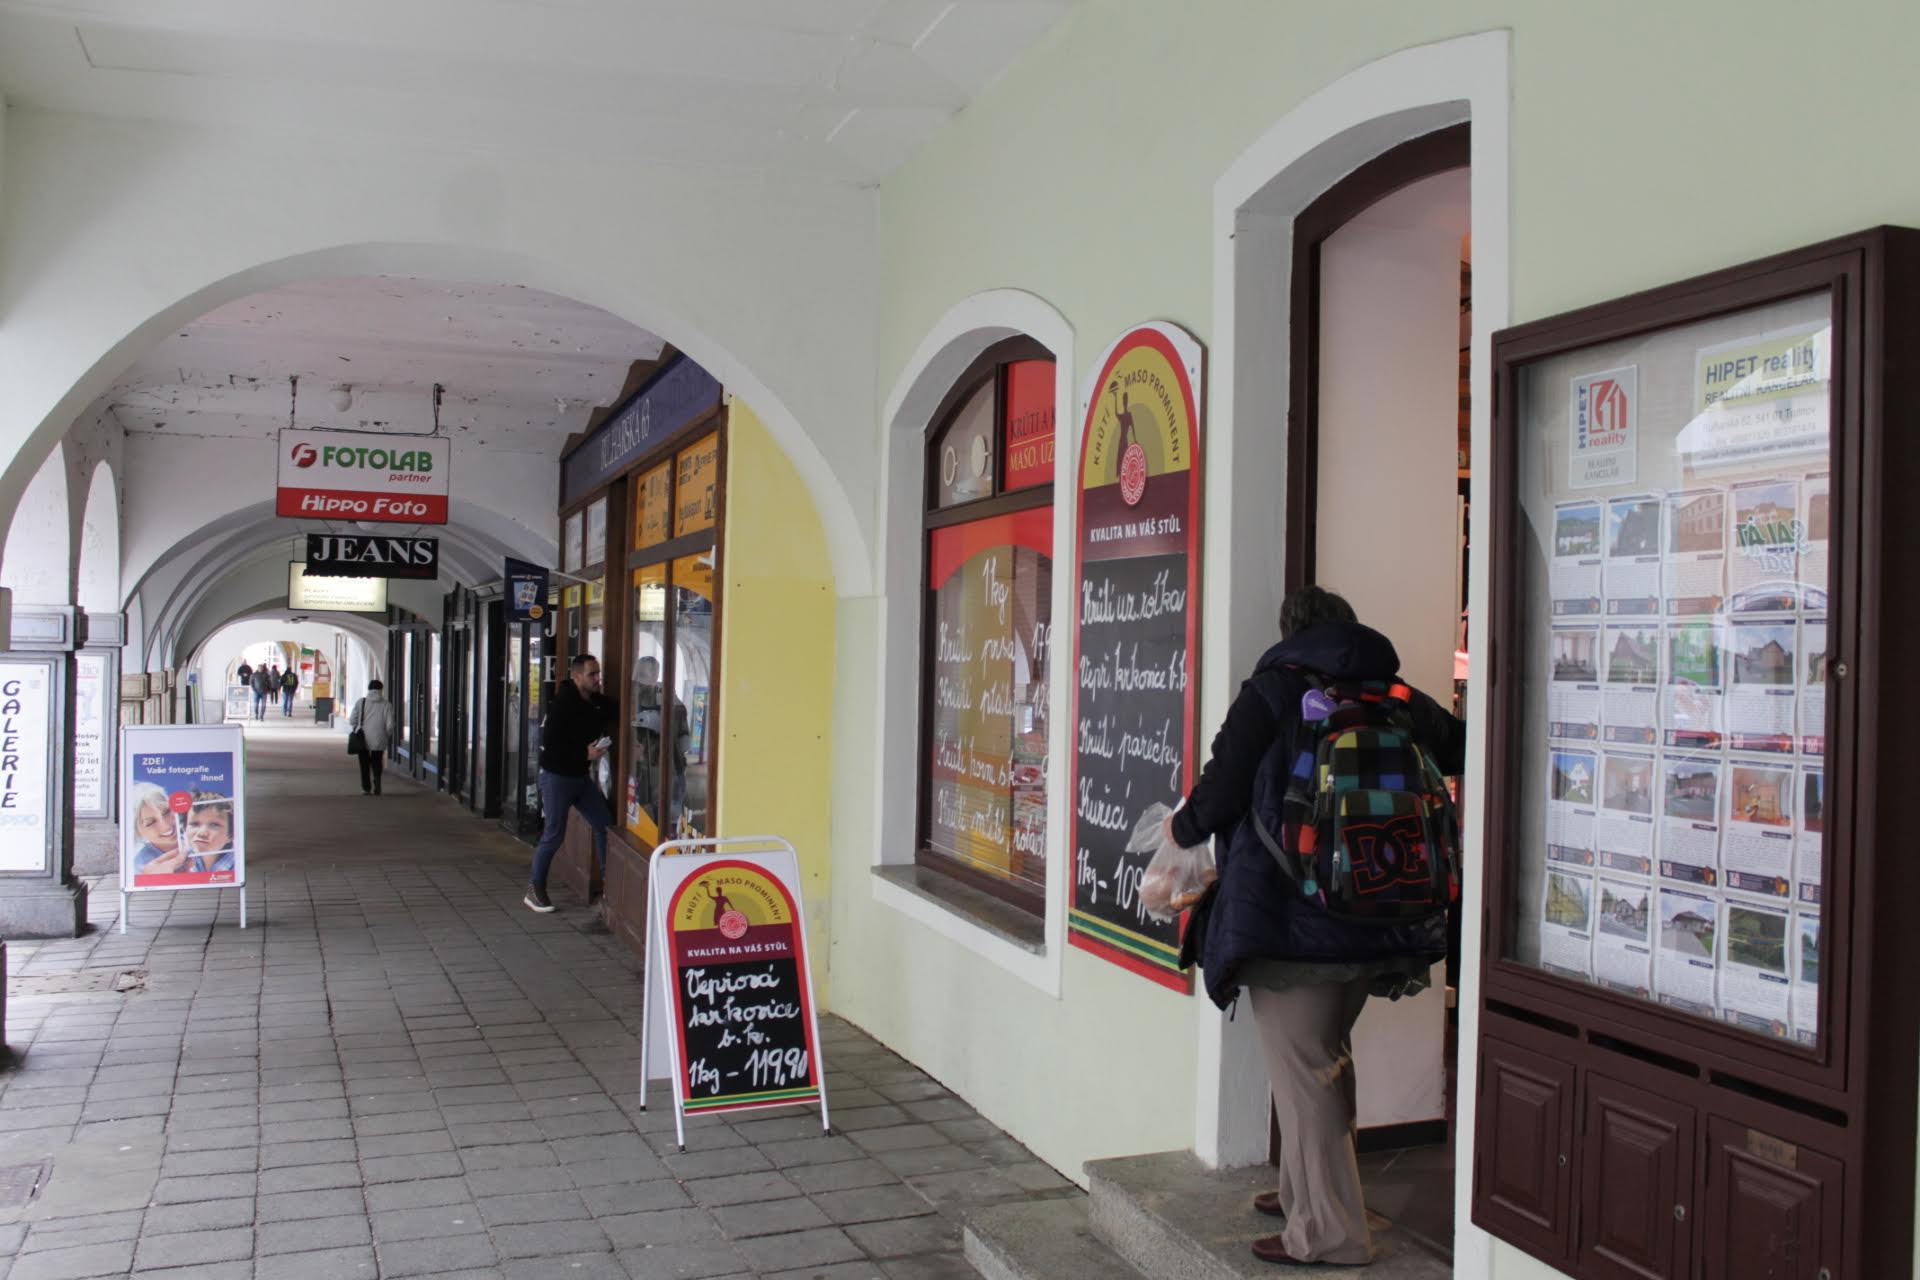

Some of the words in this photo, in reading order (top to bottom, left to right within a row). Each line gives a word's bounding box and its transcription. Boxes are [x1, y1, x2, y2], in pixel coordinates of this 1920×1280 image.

[1706, 355, 1758, 385] HIPET
[1763, 346, 1815, 373] reality
[1124, 369, 1148, 387] MASO
[1150, 373, 1180, 463] PROMINENT
[1578, 385, 1587, 449] HIPET
[323, 446, 433, 472] FOTOLAB
[1589, 433, 1626, 448] reality
[389, 473, 432, 483] partner
[373, 498, 428, 515] Foto
[1090, 524, 1123, 543] KVALITA
[1125, 523, 1136, 539] NA
[1138, 516, 1156, 536] VÁŠ
[1158, 514, 1181, 534] STŮL
[313, 537, 433, 565] JEANS
[1, 680, 21, 808] GALERIE
[142, 757, 164, 765] ZDE!
[1118, 712, 1182, 792] párečky
[147, 766, 167, 774] Vaše
[169, 765, 210, 775] fotografie
[201, 774, 224, 782] ihned
[1078, 776, 1131, 831] Kuřecí
[1341, 814, 1434, 894] DC
[1077, 847, 1097, 905] 1kg
[717, 877, 742, 886] MASO
[744, 879, 781, 920] PROMINENT
[687, 947, 727, 958] KVALITA
[729, 945, 744, 954] NA
[744, 942, 762, 953] VÁŠ
[764, 940, 788, 951] STŮL
[685, 964, 780, 1005] Vepřová
[688, 1057, 720, 1094] 1kg
[744, 1047, 808, 1087] 119,90
